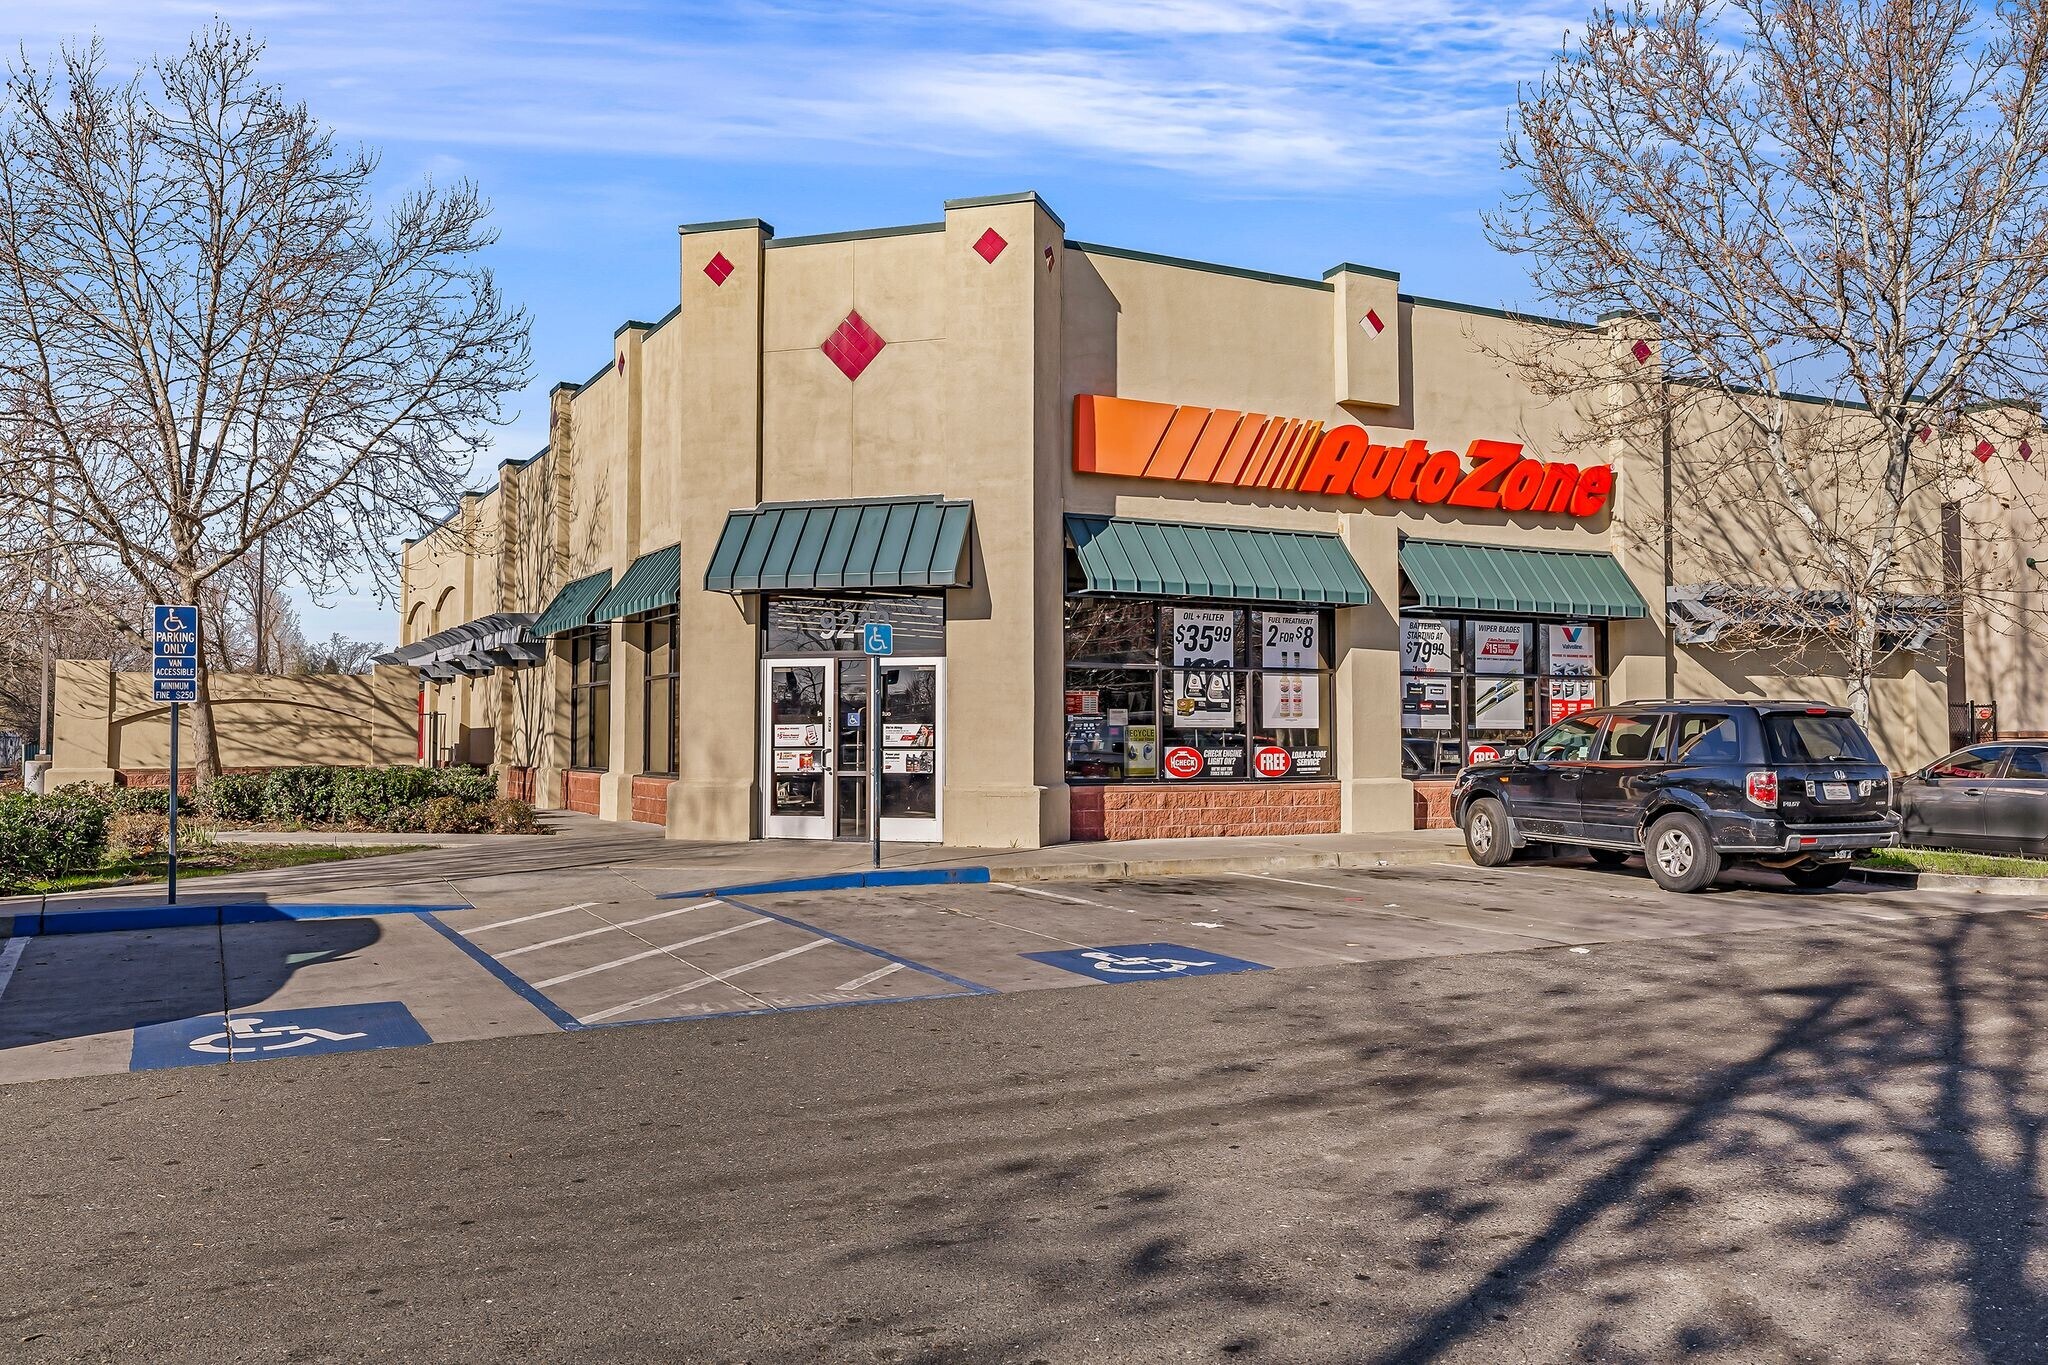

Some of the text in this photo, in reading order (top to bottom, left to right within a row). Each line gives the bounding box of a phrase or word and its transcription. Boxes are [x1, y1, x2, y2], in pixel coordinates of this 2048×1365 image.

[1299, 424, 1613, 517] AutoZone
[1183, 612, 1194, 620] OIL
[1202, 613, 1225, 622] FILTER
[1282, 617, 1314, 625] TREATMENT
[1409, 622, 1441, 631] BATTERIES
[1499, 625, 1521, 633] BLADES
[156, 632, 195, 643] PARKING
[1266, 625, 1314, 648] 2 FOR $8
[1407, 631, 1444, 640] STARTING AT
[163, 643, 187, 654] ONLY
[1485, 643, 1498, 654] $15
[168, 659, 183, 667] VAN
[155, 668, 195, 676] ACCESSIBLE
[161, 682, 189, 690] MINIMUM
[155, 691, 194, 699] FINE $250
[1125, 729, 1155, 737] RECYCLE
[1203, 749, 1243, 758] CHECK ENGINE
[1207, 757, 1237, 765] LIGHT ON?
[1260, 753, 1286, 771] FREE
[1296, 758, 1321, 767] SERVICE
